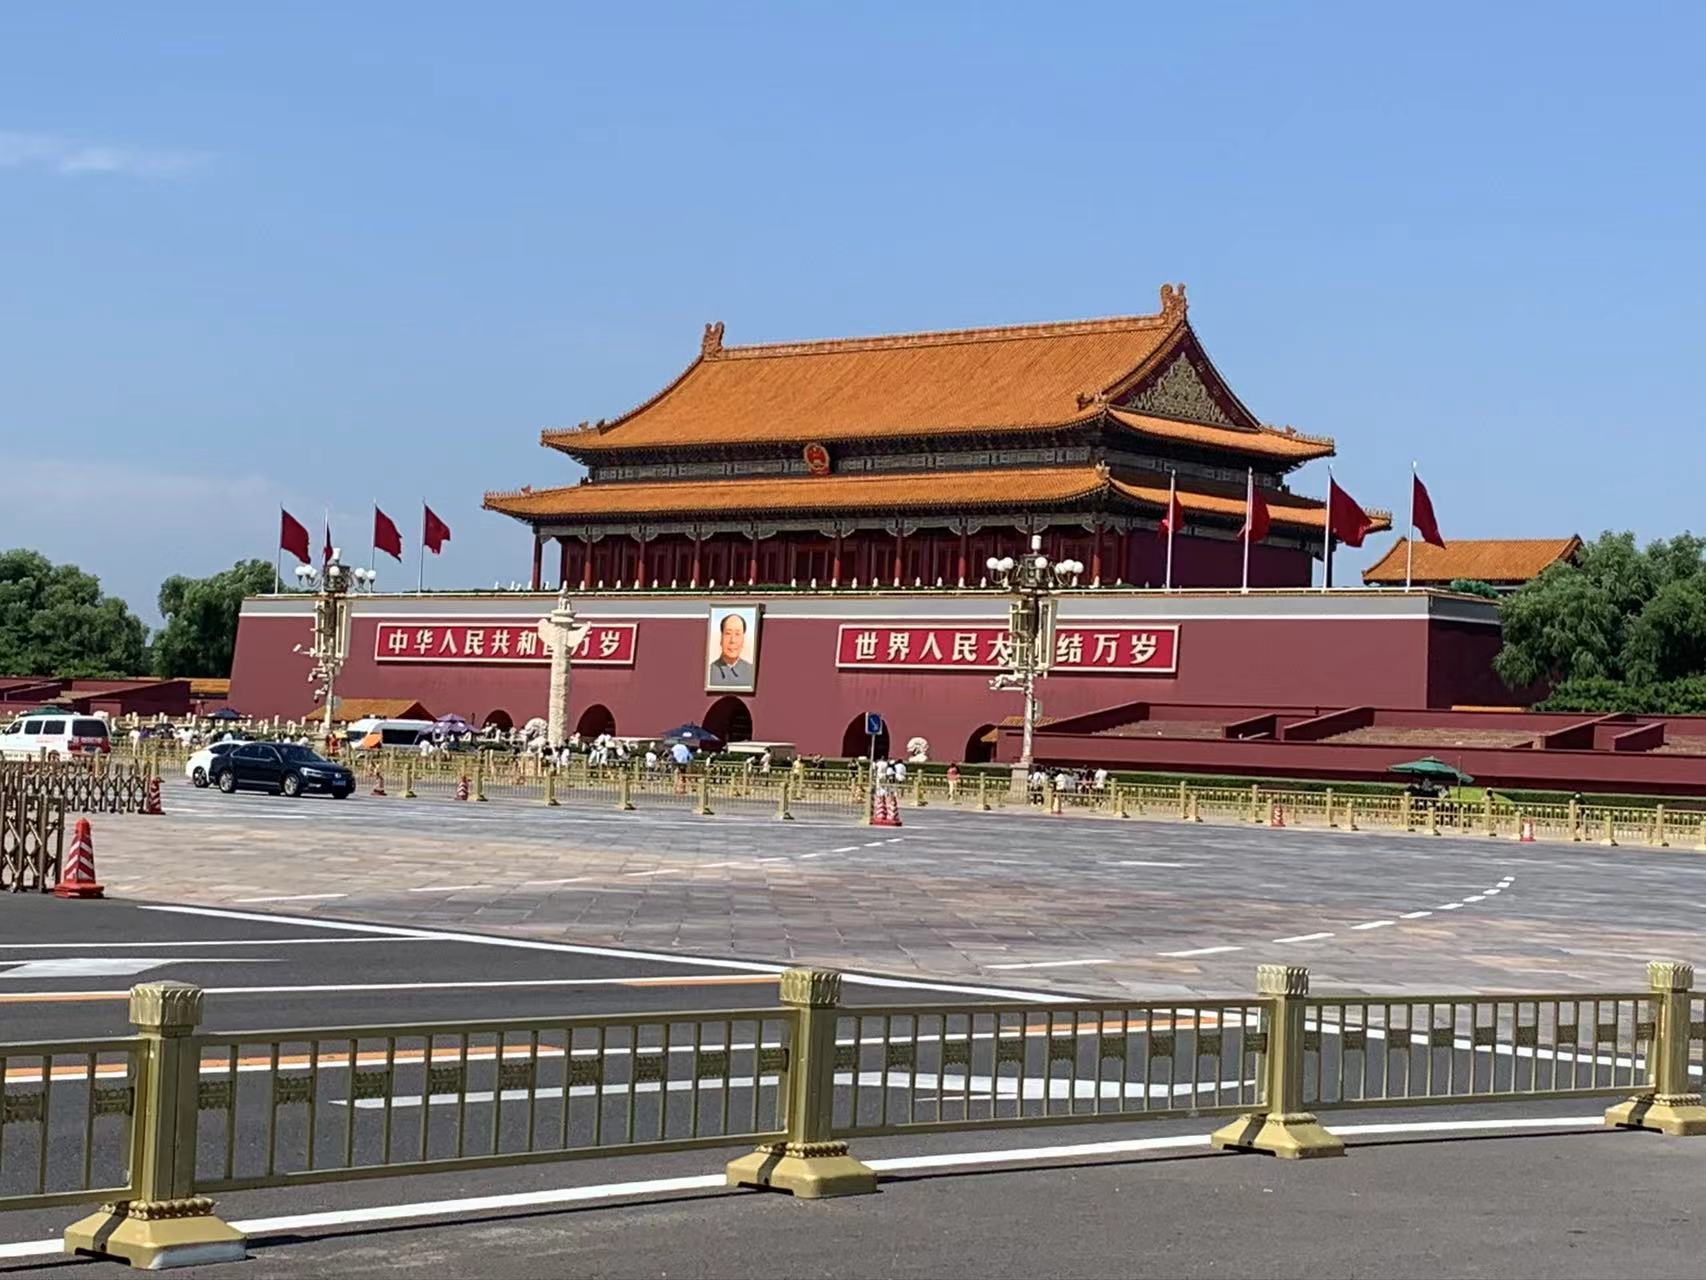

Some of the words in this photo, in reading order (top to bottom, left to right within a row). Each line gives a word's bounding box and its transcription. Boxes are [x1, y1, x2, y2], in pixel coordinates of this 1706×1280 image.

[856, 631, 1158, 664] 世界人民大结万岁
